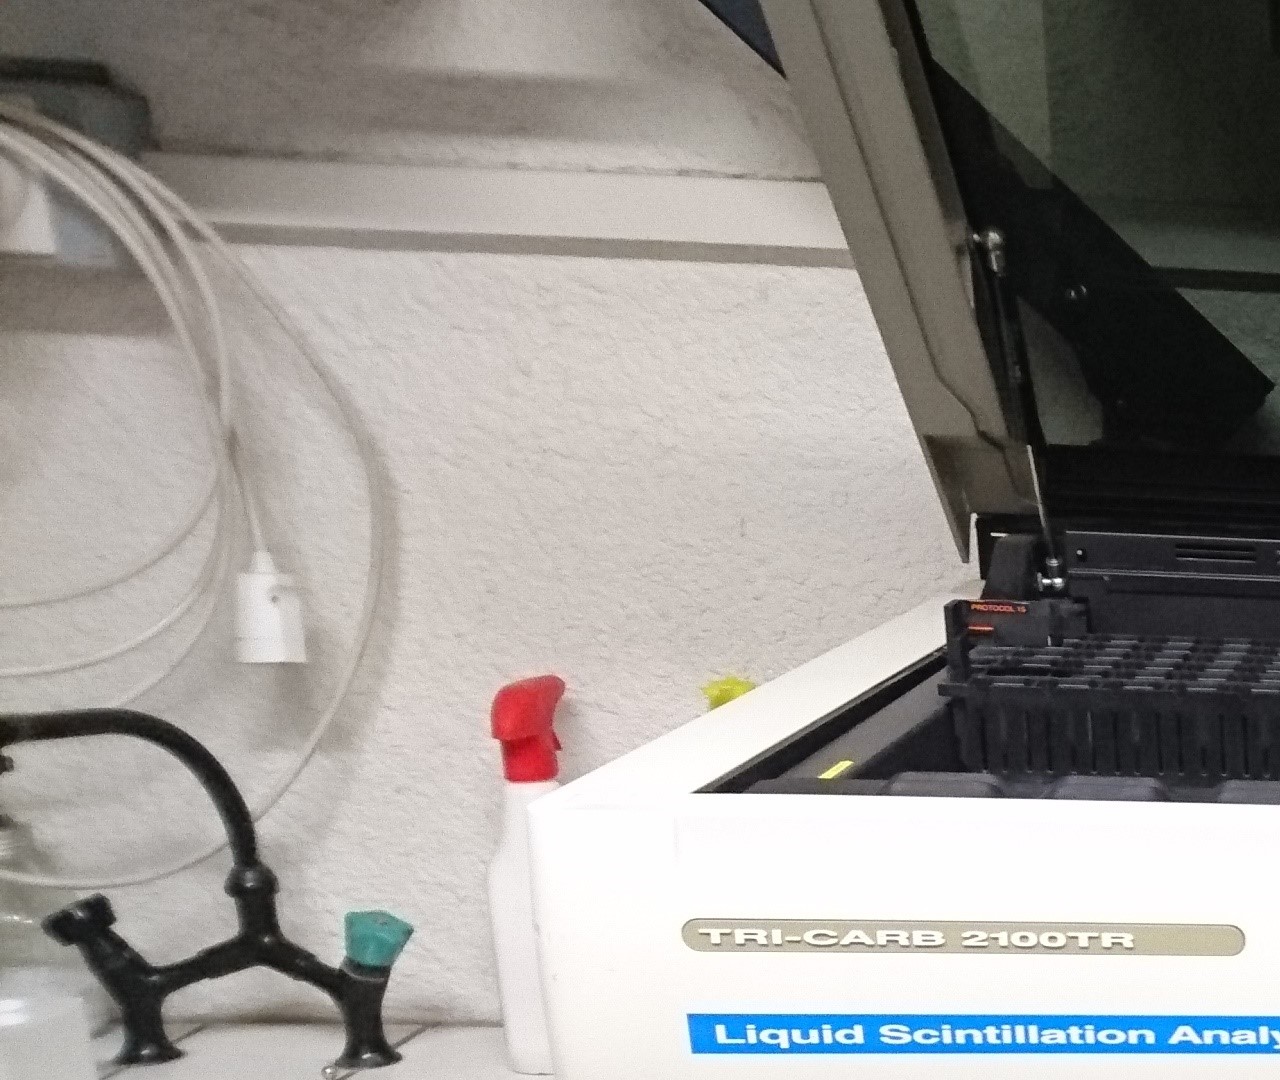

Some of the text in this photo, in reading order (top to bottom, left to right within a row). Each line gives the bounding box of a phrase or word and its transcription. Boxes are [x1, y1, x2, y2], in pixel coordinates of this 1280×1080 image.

[970, 603, 1015, 613] PROTOCOL
[697, 927, 1136, 951] TRI-CARB 2100TR
[713, 1022, 866, 1051] Liquid
[878, 1023, 1157, 1047] Scintillation
